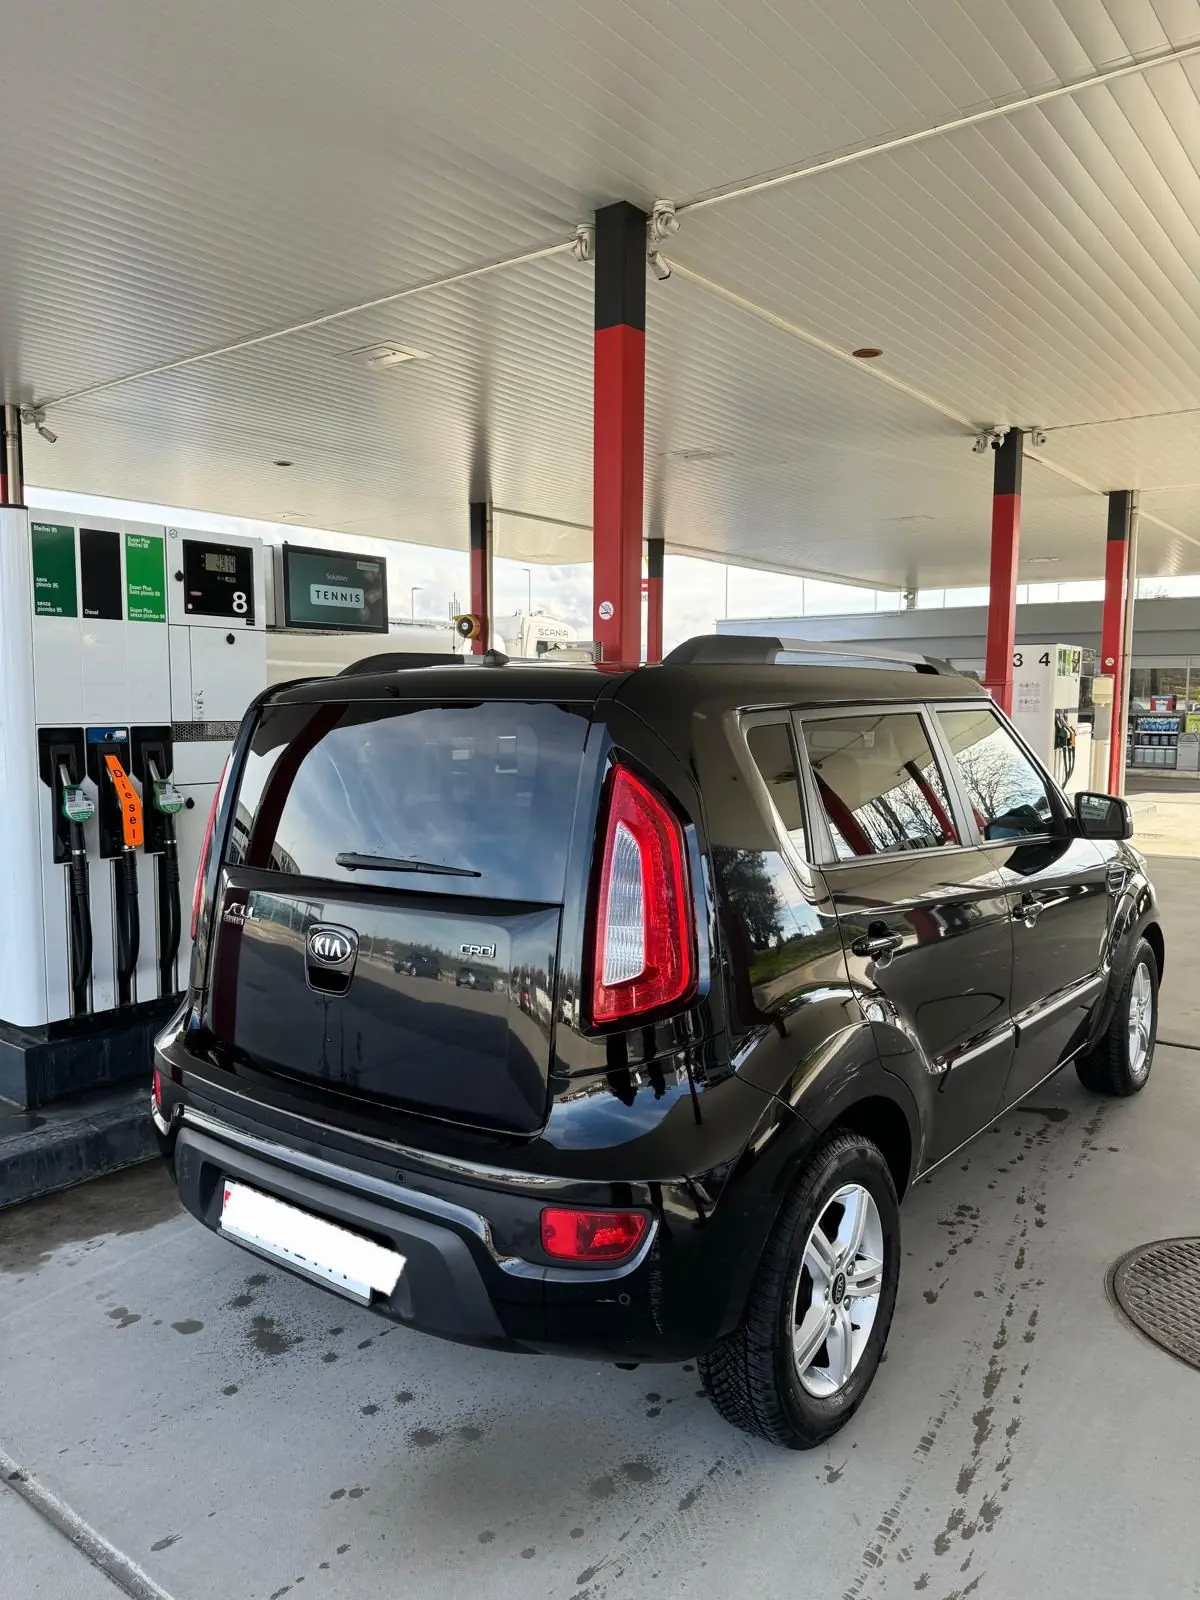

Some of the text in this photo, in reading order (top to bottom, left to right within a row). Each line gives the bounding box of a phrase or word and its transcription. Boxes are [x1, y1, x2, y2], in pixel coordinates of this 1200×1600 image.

[232, 591, 248, 614] 8
[315, 590, 361, 603] TENNIS
[538, 628, 569, 638] SCANIA
[1012, 652, 1051, 668] 3 4
[113, 769, 137, 840] Diesel
[314, 936, 342, 958] KIA
